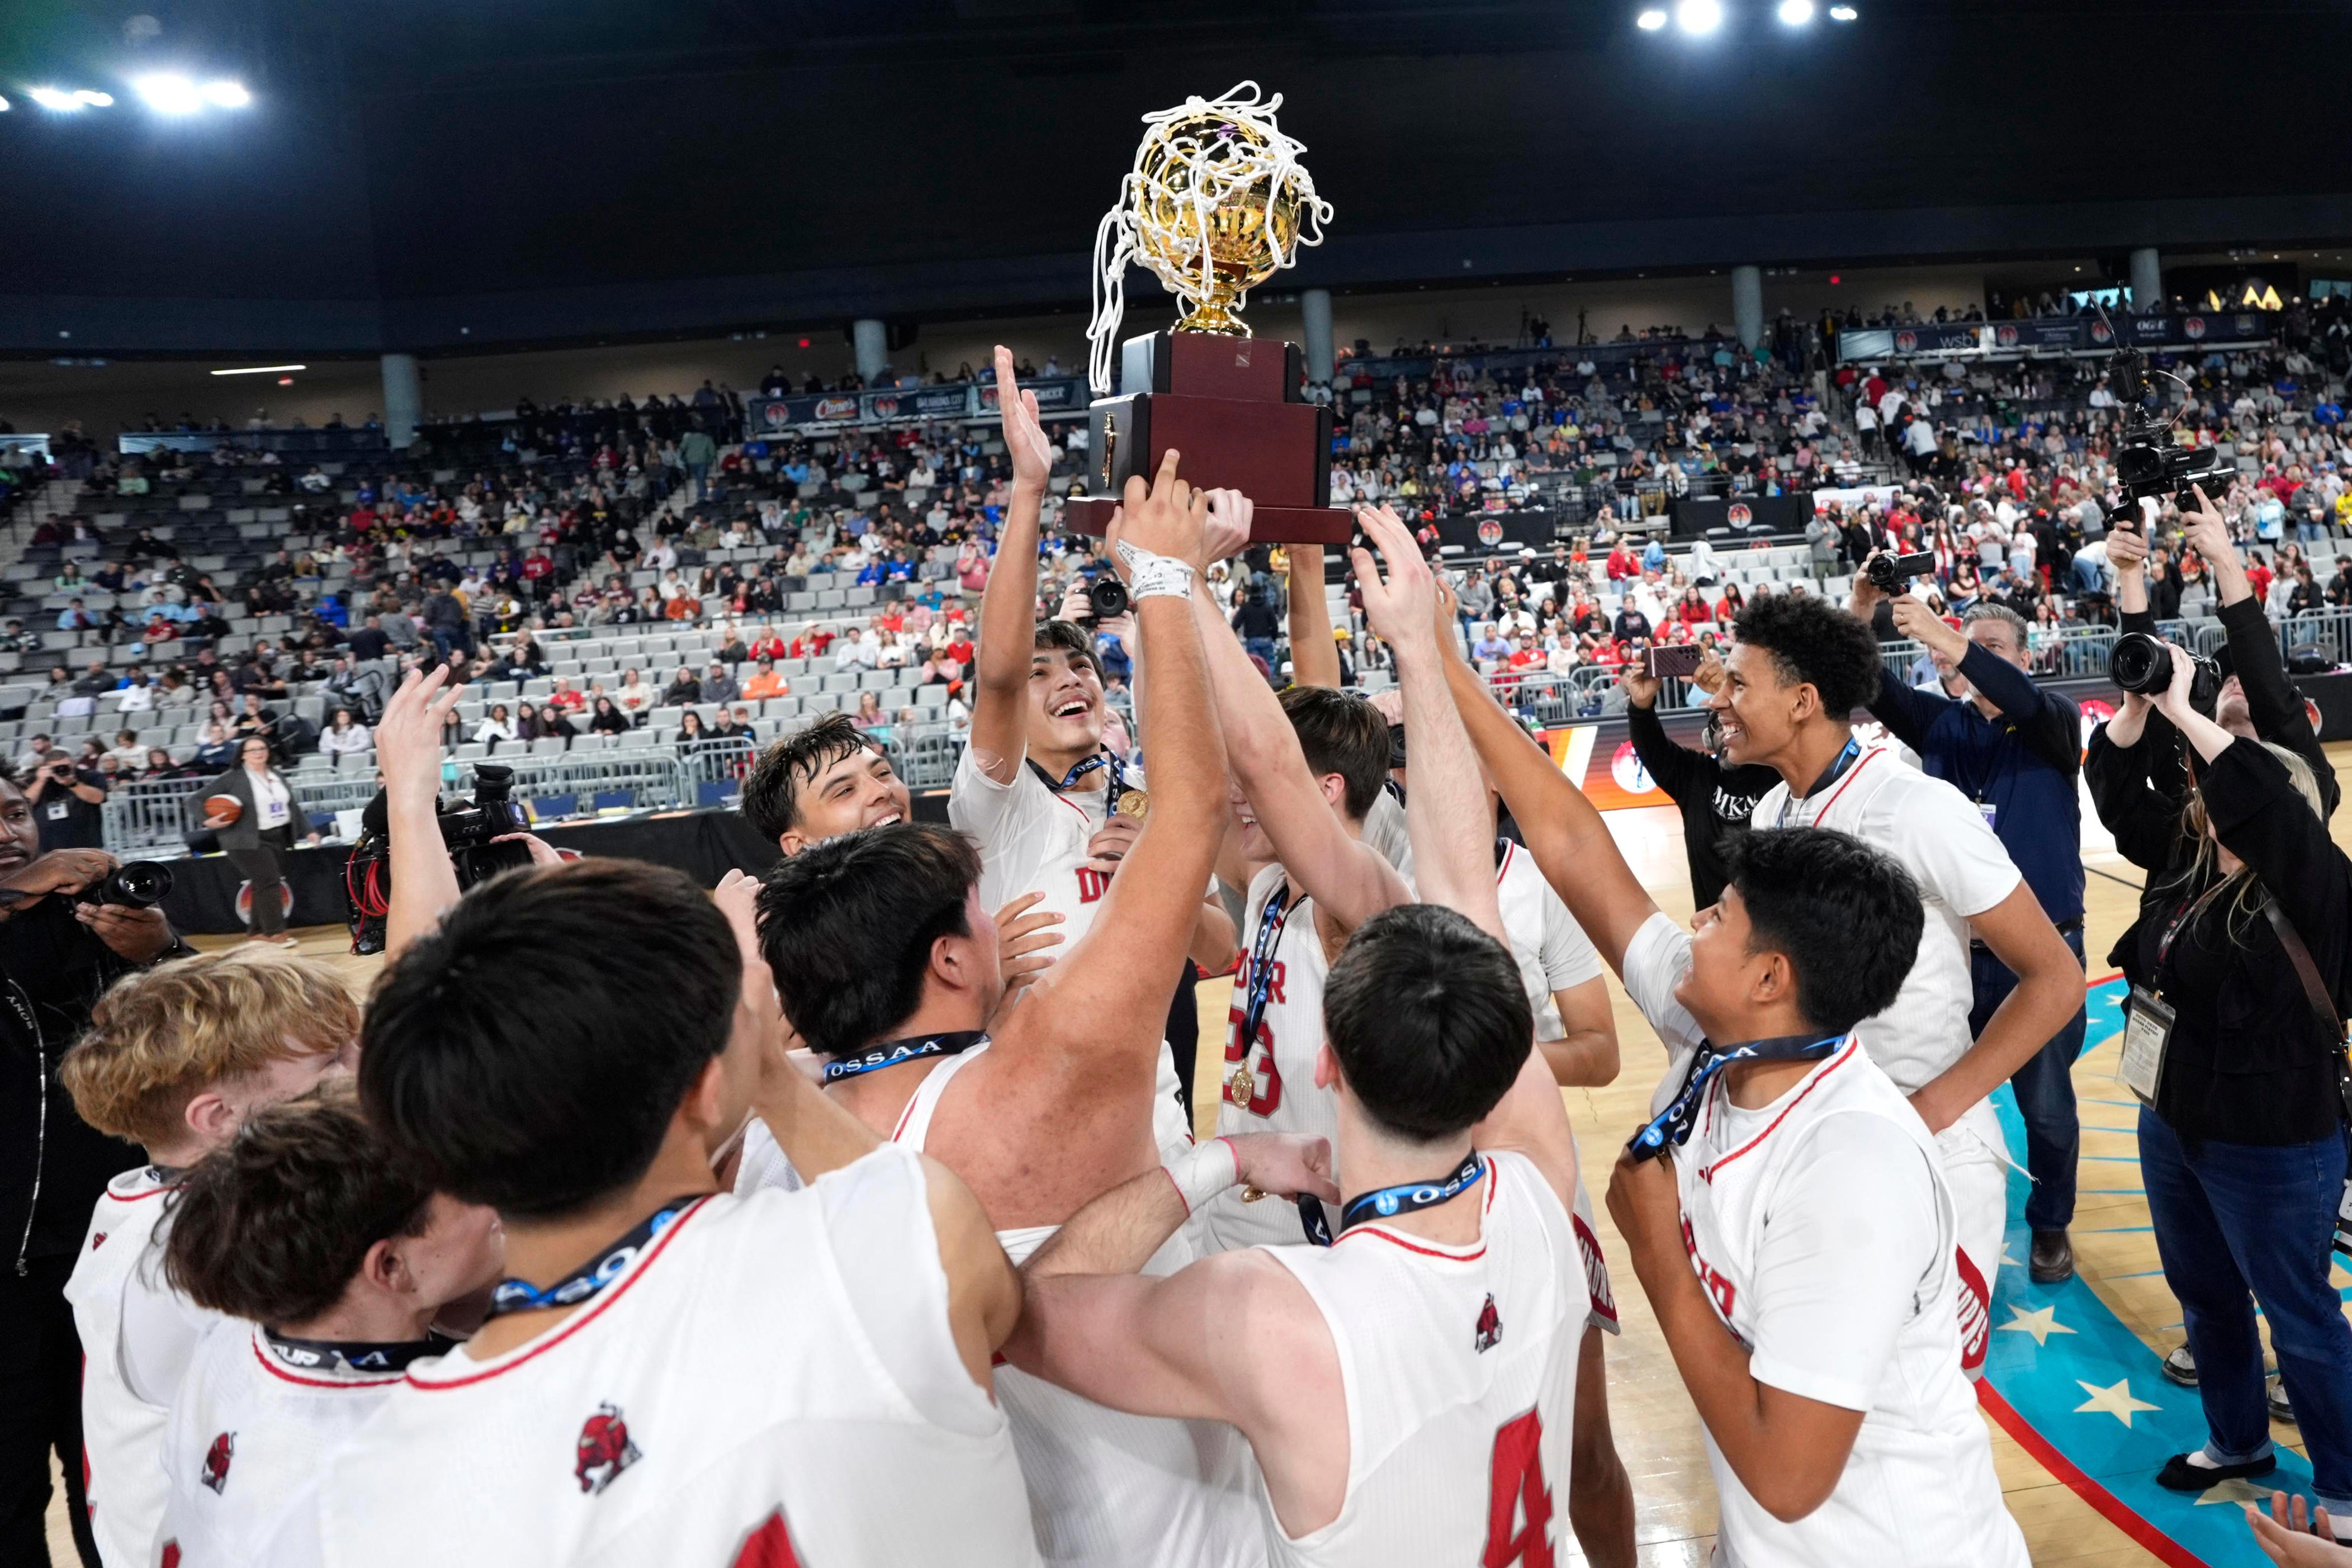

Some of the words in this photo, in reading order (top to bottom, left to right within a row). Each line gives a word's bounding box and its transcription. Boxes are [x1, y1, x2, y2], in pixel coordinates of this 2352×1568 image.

[1939, 334, 1974, 348] wsb
[515, 804, 523, 822] 4
[831, 1040, 942, 1077] OSSAA
[1478, 1399, 1556, 1568] 4
